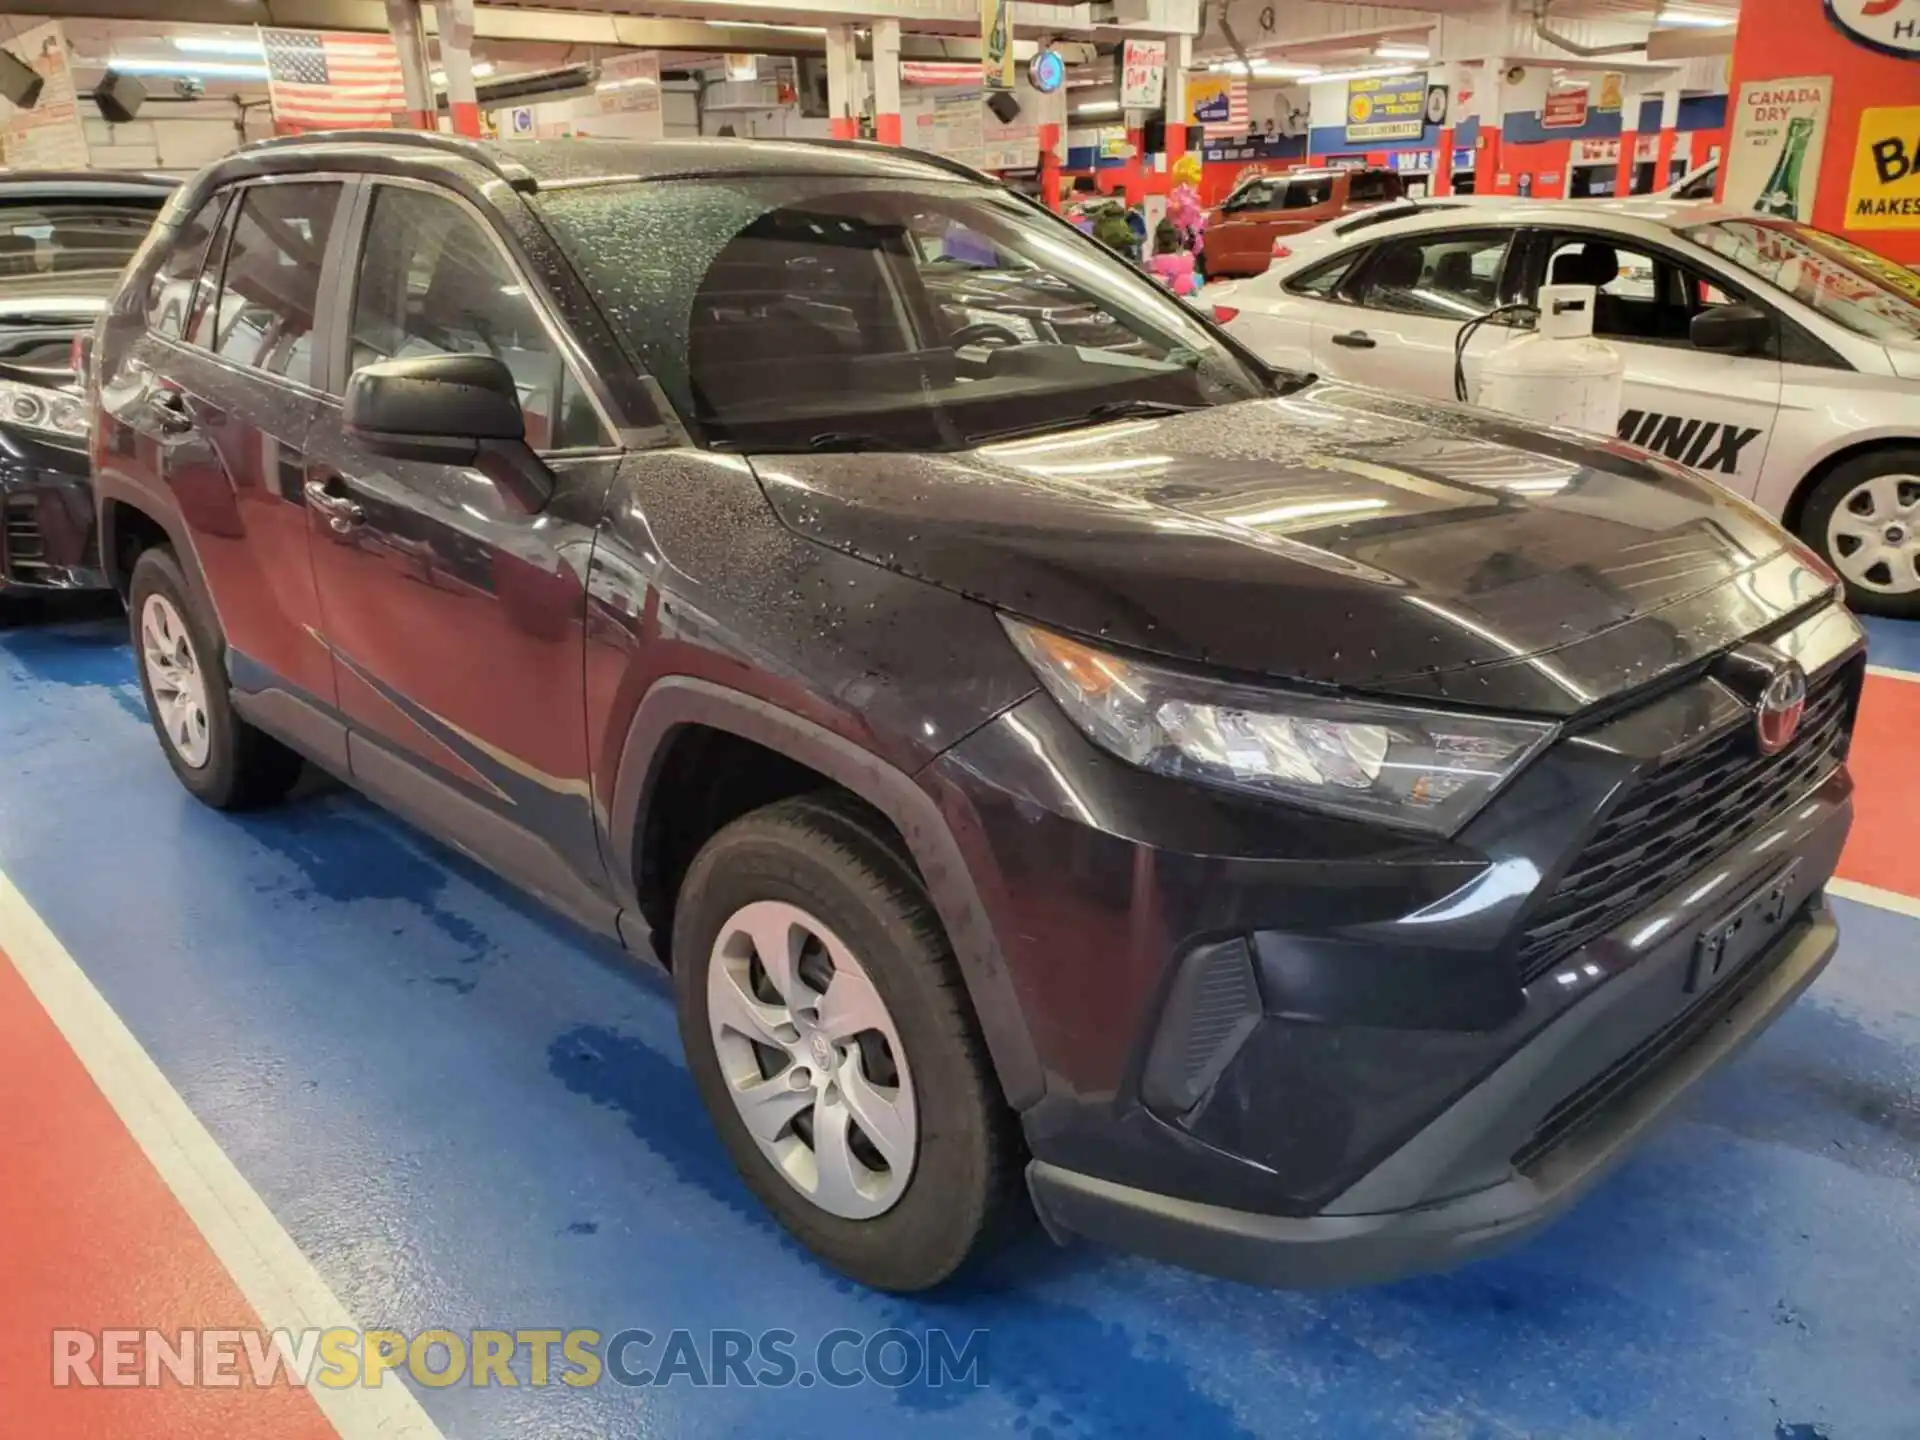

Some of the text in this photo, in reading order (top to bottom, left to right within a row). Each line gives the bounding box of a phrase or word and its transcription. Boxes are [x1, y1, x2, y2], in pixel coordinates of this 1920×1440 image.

[1893, 19, 1920, 40] H
[1747, 88, 1821, 105] CANADA
[1755, 106, 1790, 121] DRY
[1855, 198, 1920, 216] MAKES
